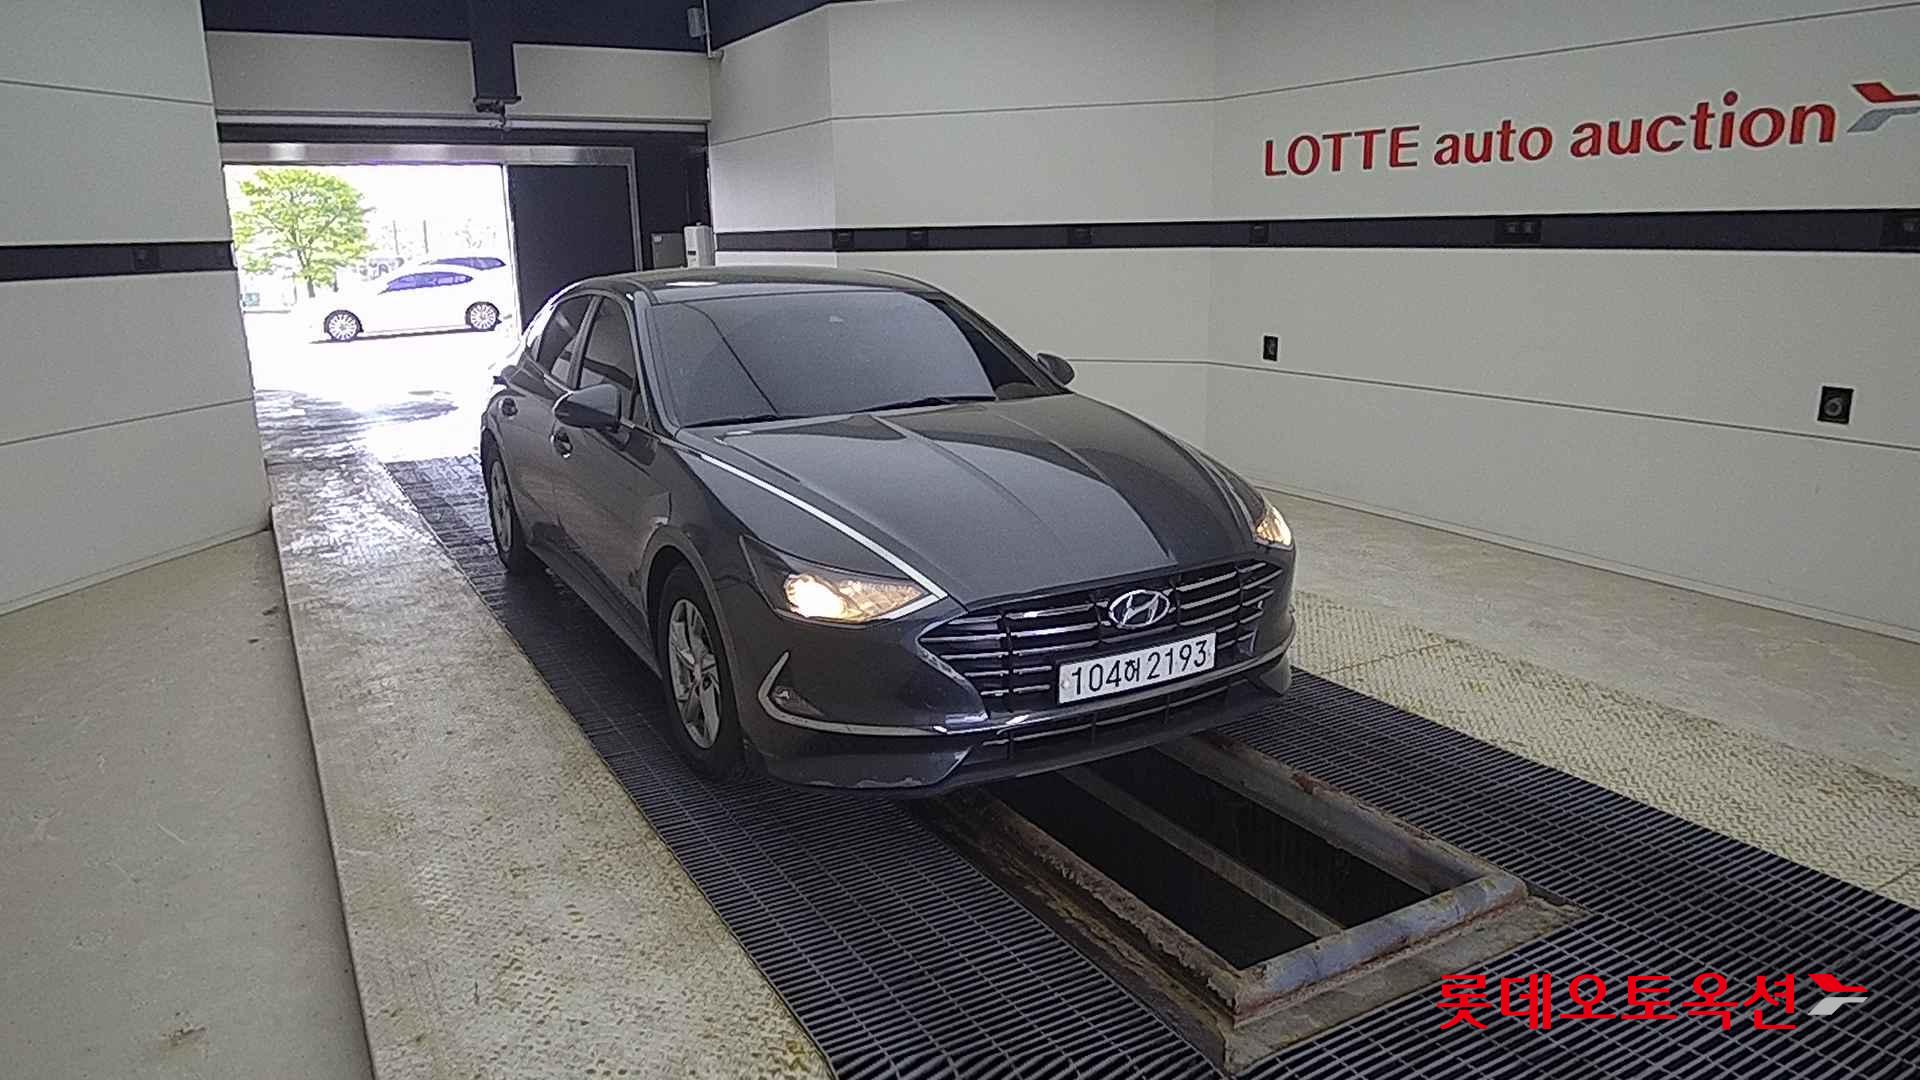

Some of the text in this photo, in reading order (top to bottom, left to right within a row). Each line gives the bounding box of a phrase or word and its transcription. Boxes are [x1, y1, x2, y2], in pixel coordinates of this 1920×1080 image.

[1264, 91, 1837, 177] LOTTE auto auction
